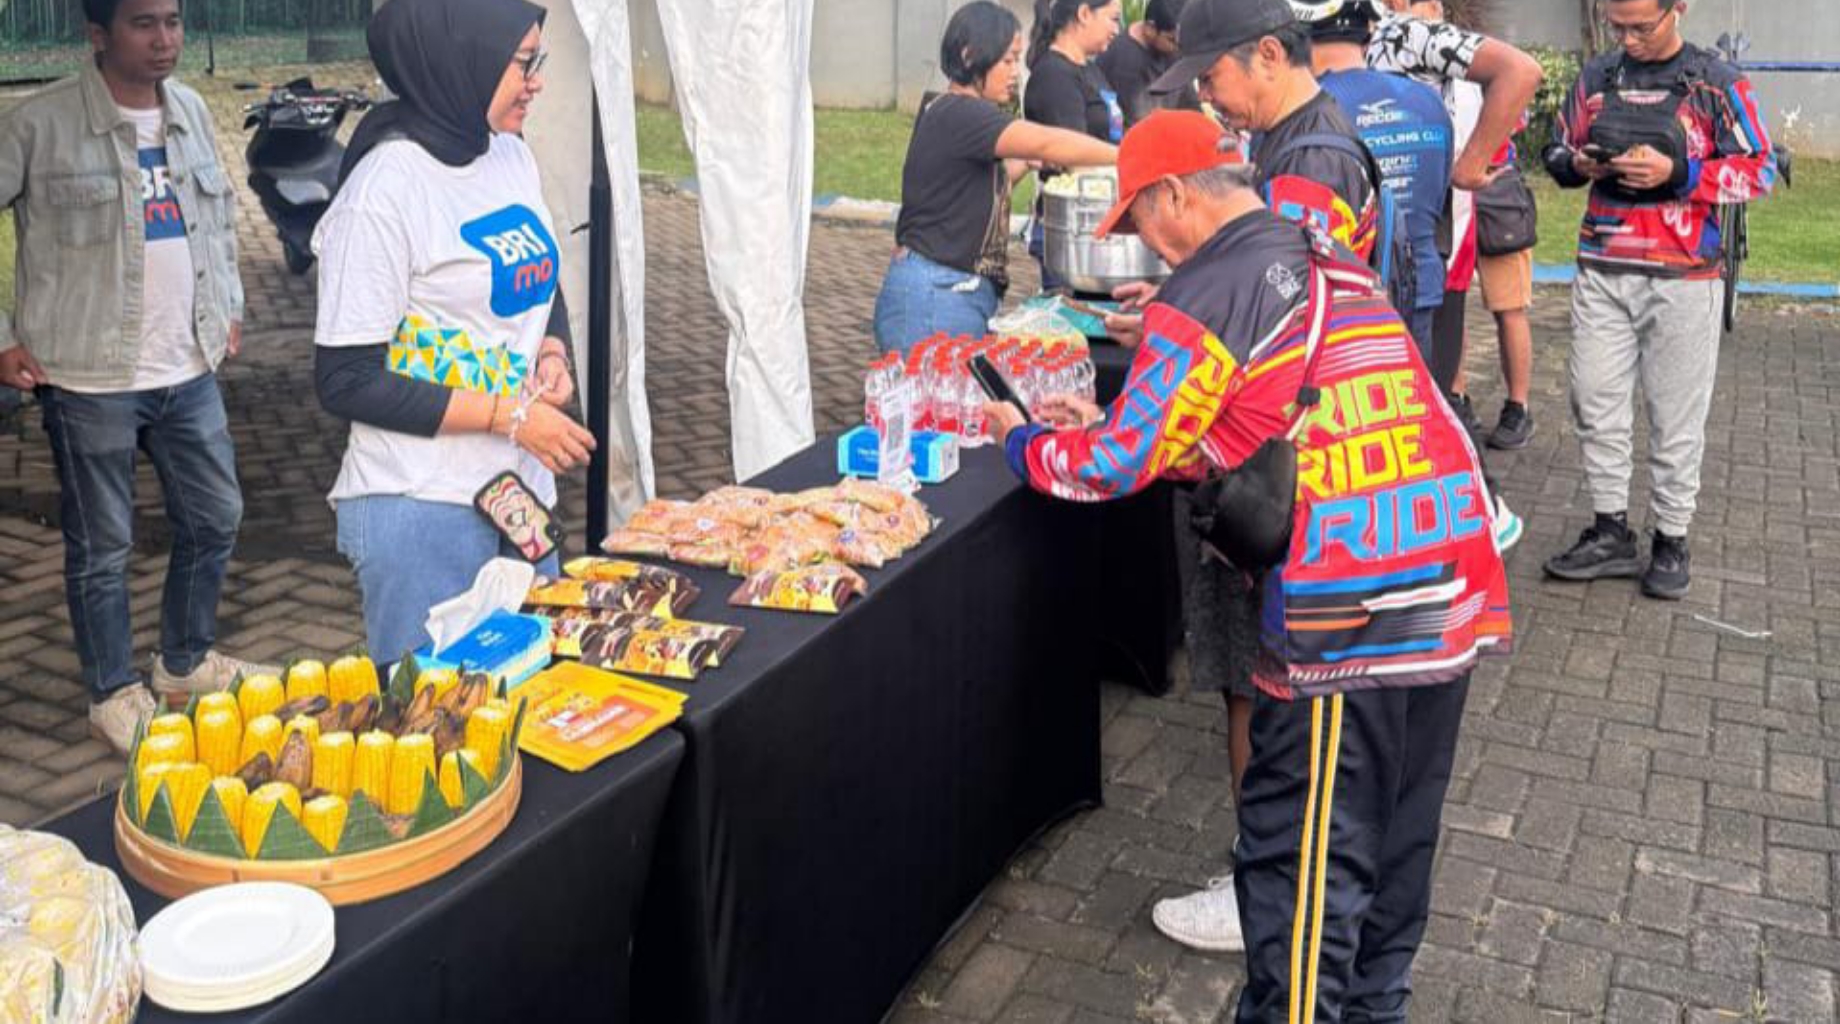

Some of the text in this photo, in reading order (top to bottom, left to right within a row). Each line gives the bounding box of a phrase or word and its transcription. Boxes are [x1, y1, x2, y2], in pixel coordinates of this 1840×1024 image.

[139, 166, 172, 199] BR
[144, 201, 180, 222] m
[481, 222, 549, 266] BRI
[514, 257, 553, 294] mo
[1283, 369, 1427, 445] RIDE
[1297, 424, 1433, 501] RIDE
[1303, 471, 1484, 565] RIDE
